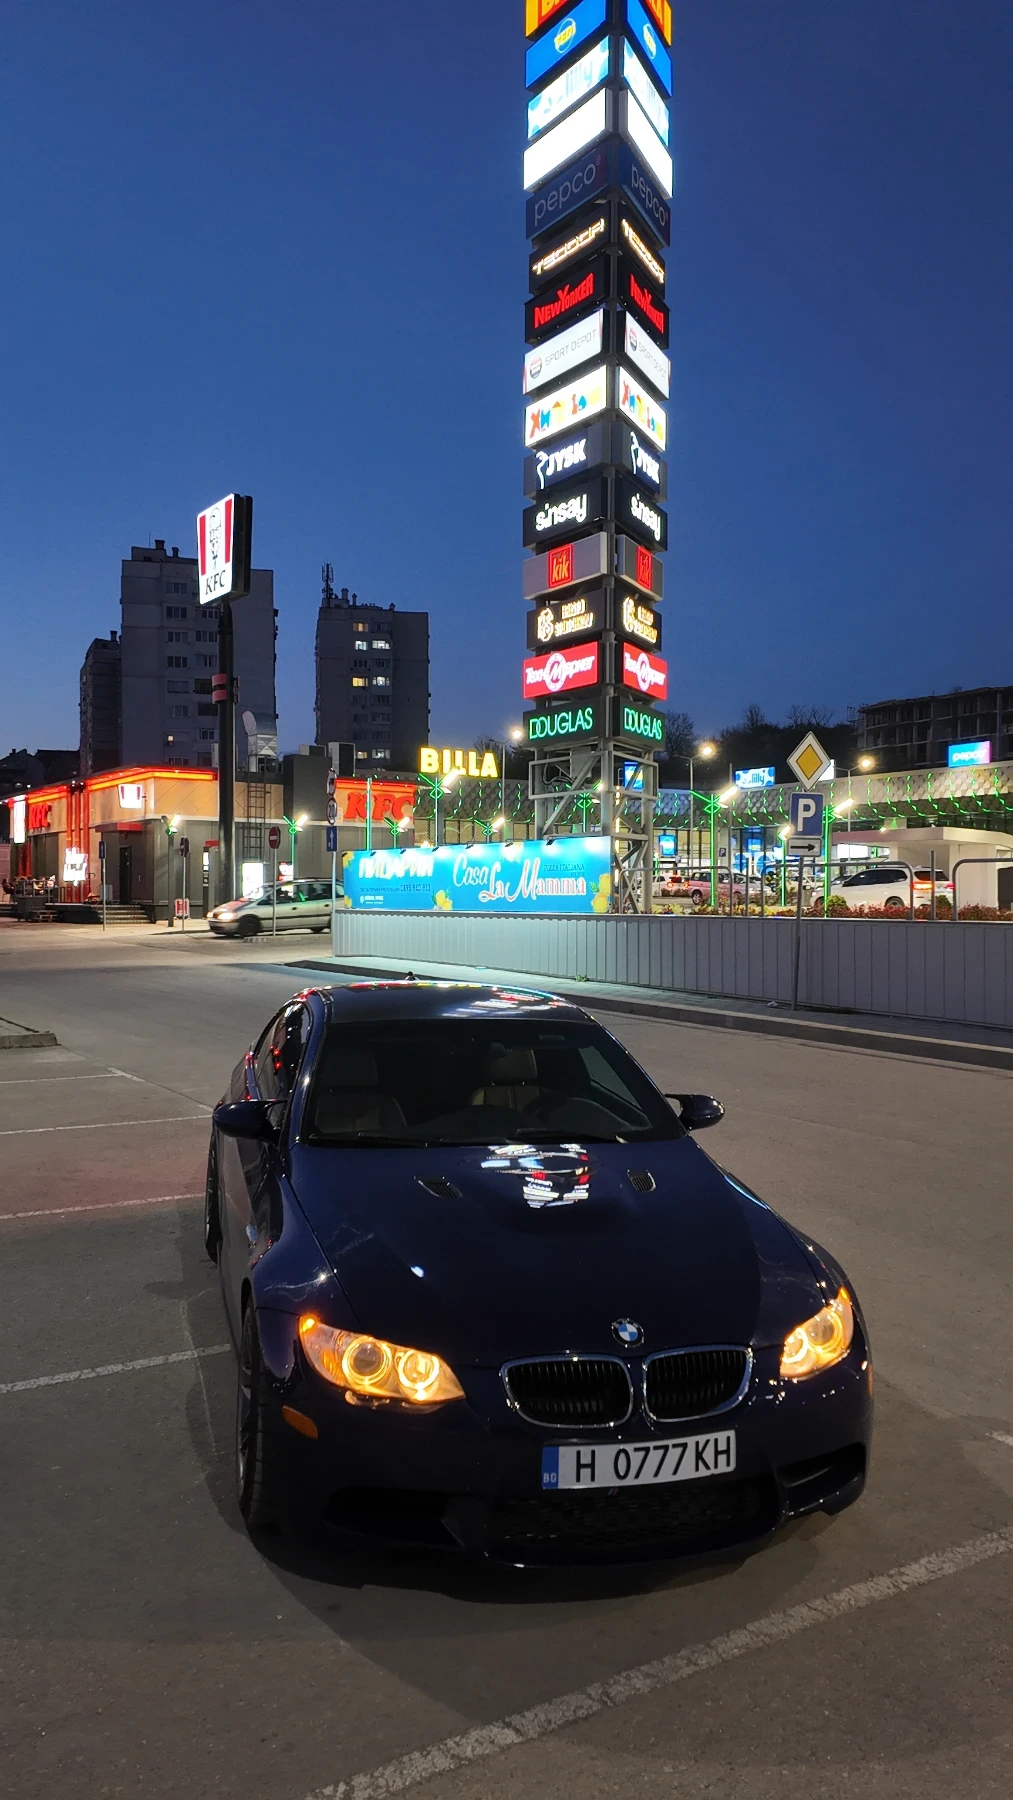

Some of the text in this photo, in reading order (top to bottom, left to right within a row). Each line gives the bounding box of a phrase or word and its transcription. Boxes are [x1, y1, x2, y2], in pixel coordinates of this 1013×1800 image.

[534, 163, 597, 227] pepco
[631, 163, 666, 227] pepco
[544, 329, 597, 366] SPORT DEPOT
[546, 438, 587, 476] JYSK
[636, 445, 660, 484] JYSK
[535, 493, 588, 531] sinsay
[204, 569, 226, 596] KFC
[529, 706, 593, 740] DOUGLAS
[623, 707, 663, 740] DOUGLAS
[419, 747, 499, 778] BILLA
[952, 750, 985, 763] pepco
[28, 804, 52, 830] KFC
[344, 791, 412, 821] KFC
[797, 798, 816, 832] P
[453, 853, 489, 887] Casa
[478, 857, 587, 902] La Mamma
[543, 1472, 557, 1484] BG
[575, 1449, 596, 1483] H
